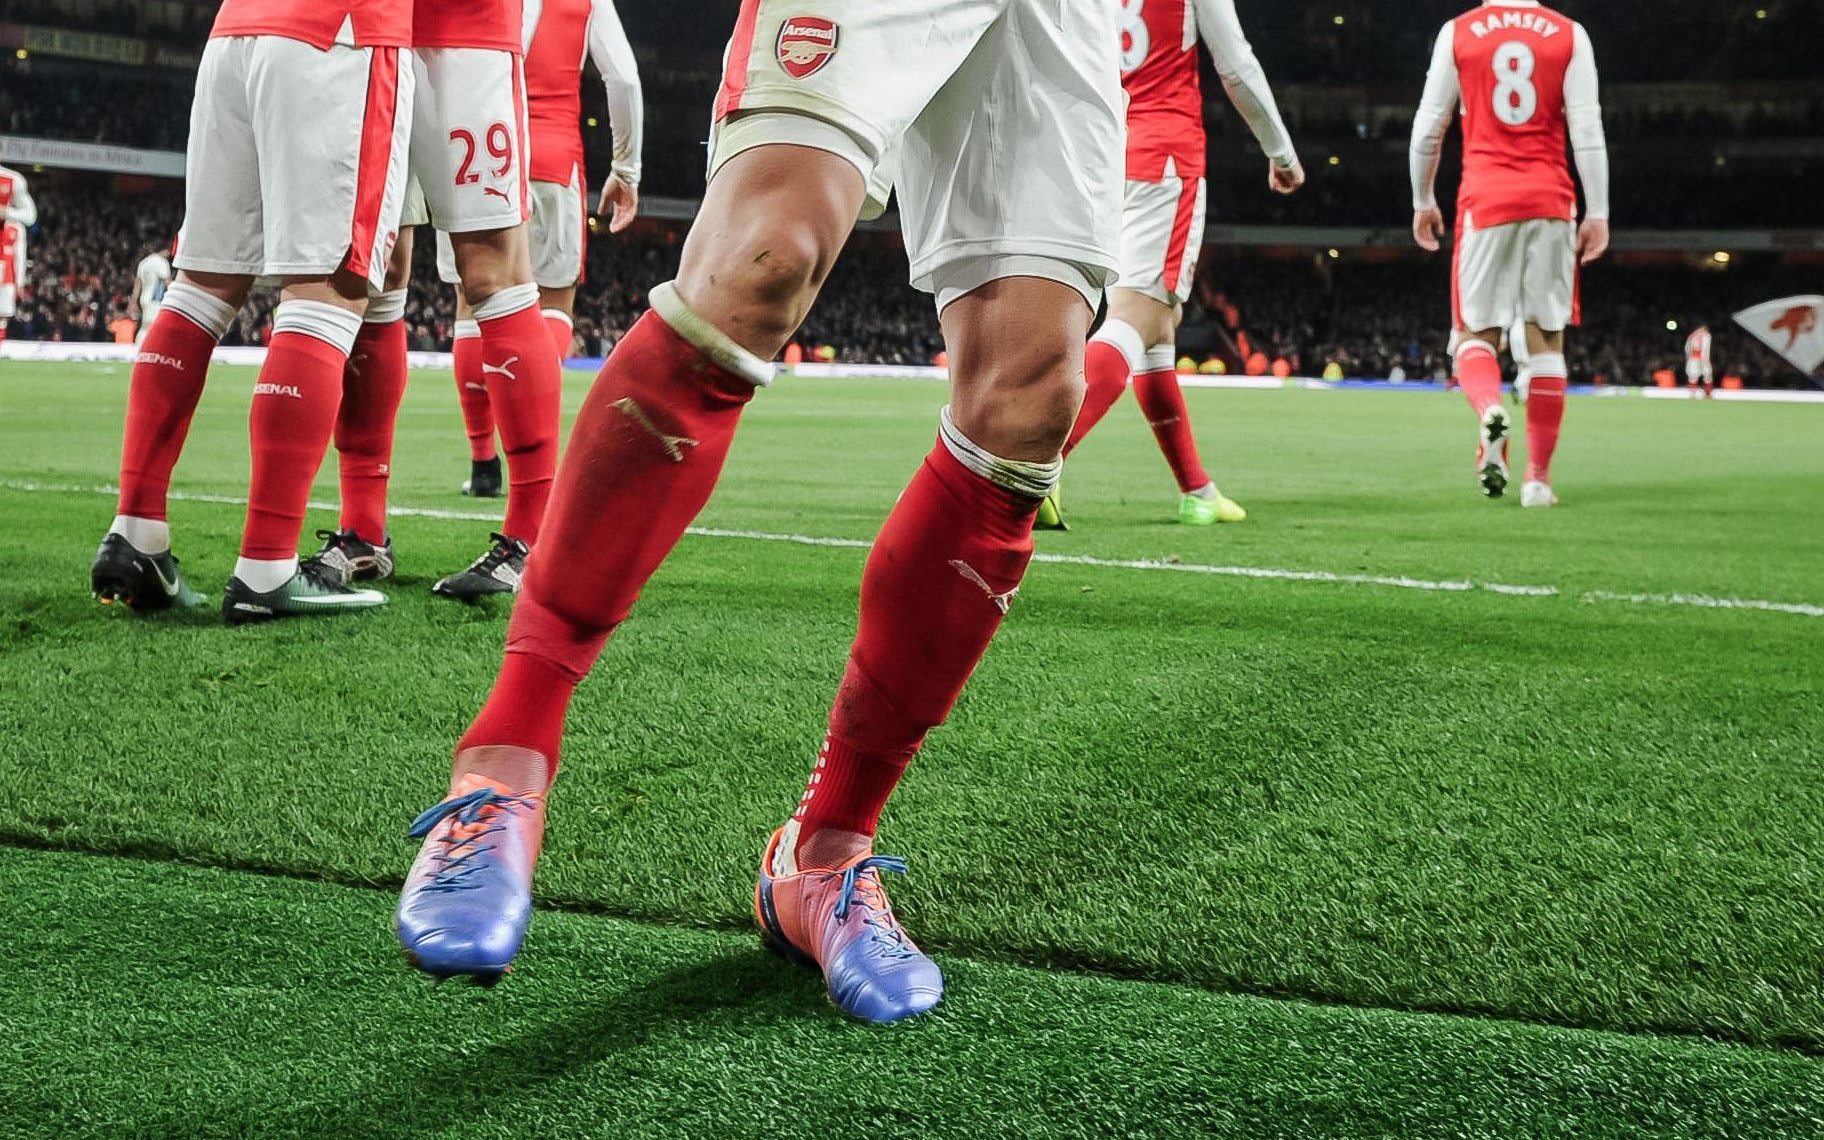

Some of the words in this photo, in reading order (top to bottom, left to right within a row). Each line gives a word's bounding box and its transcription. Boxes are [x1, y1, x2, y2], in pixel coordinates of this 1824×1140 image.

[784, 24, 833, 39] Arsenal
[1471, 11, 1559, 38] RAMSEY
[1492, 42, 1537, 125] 8
[449, 122, 512, 186] 29
